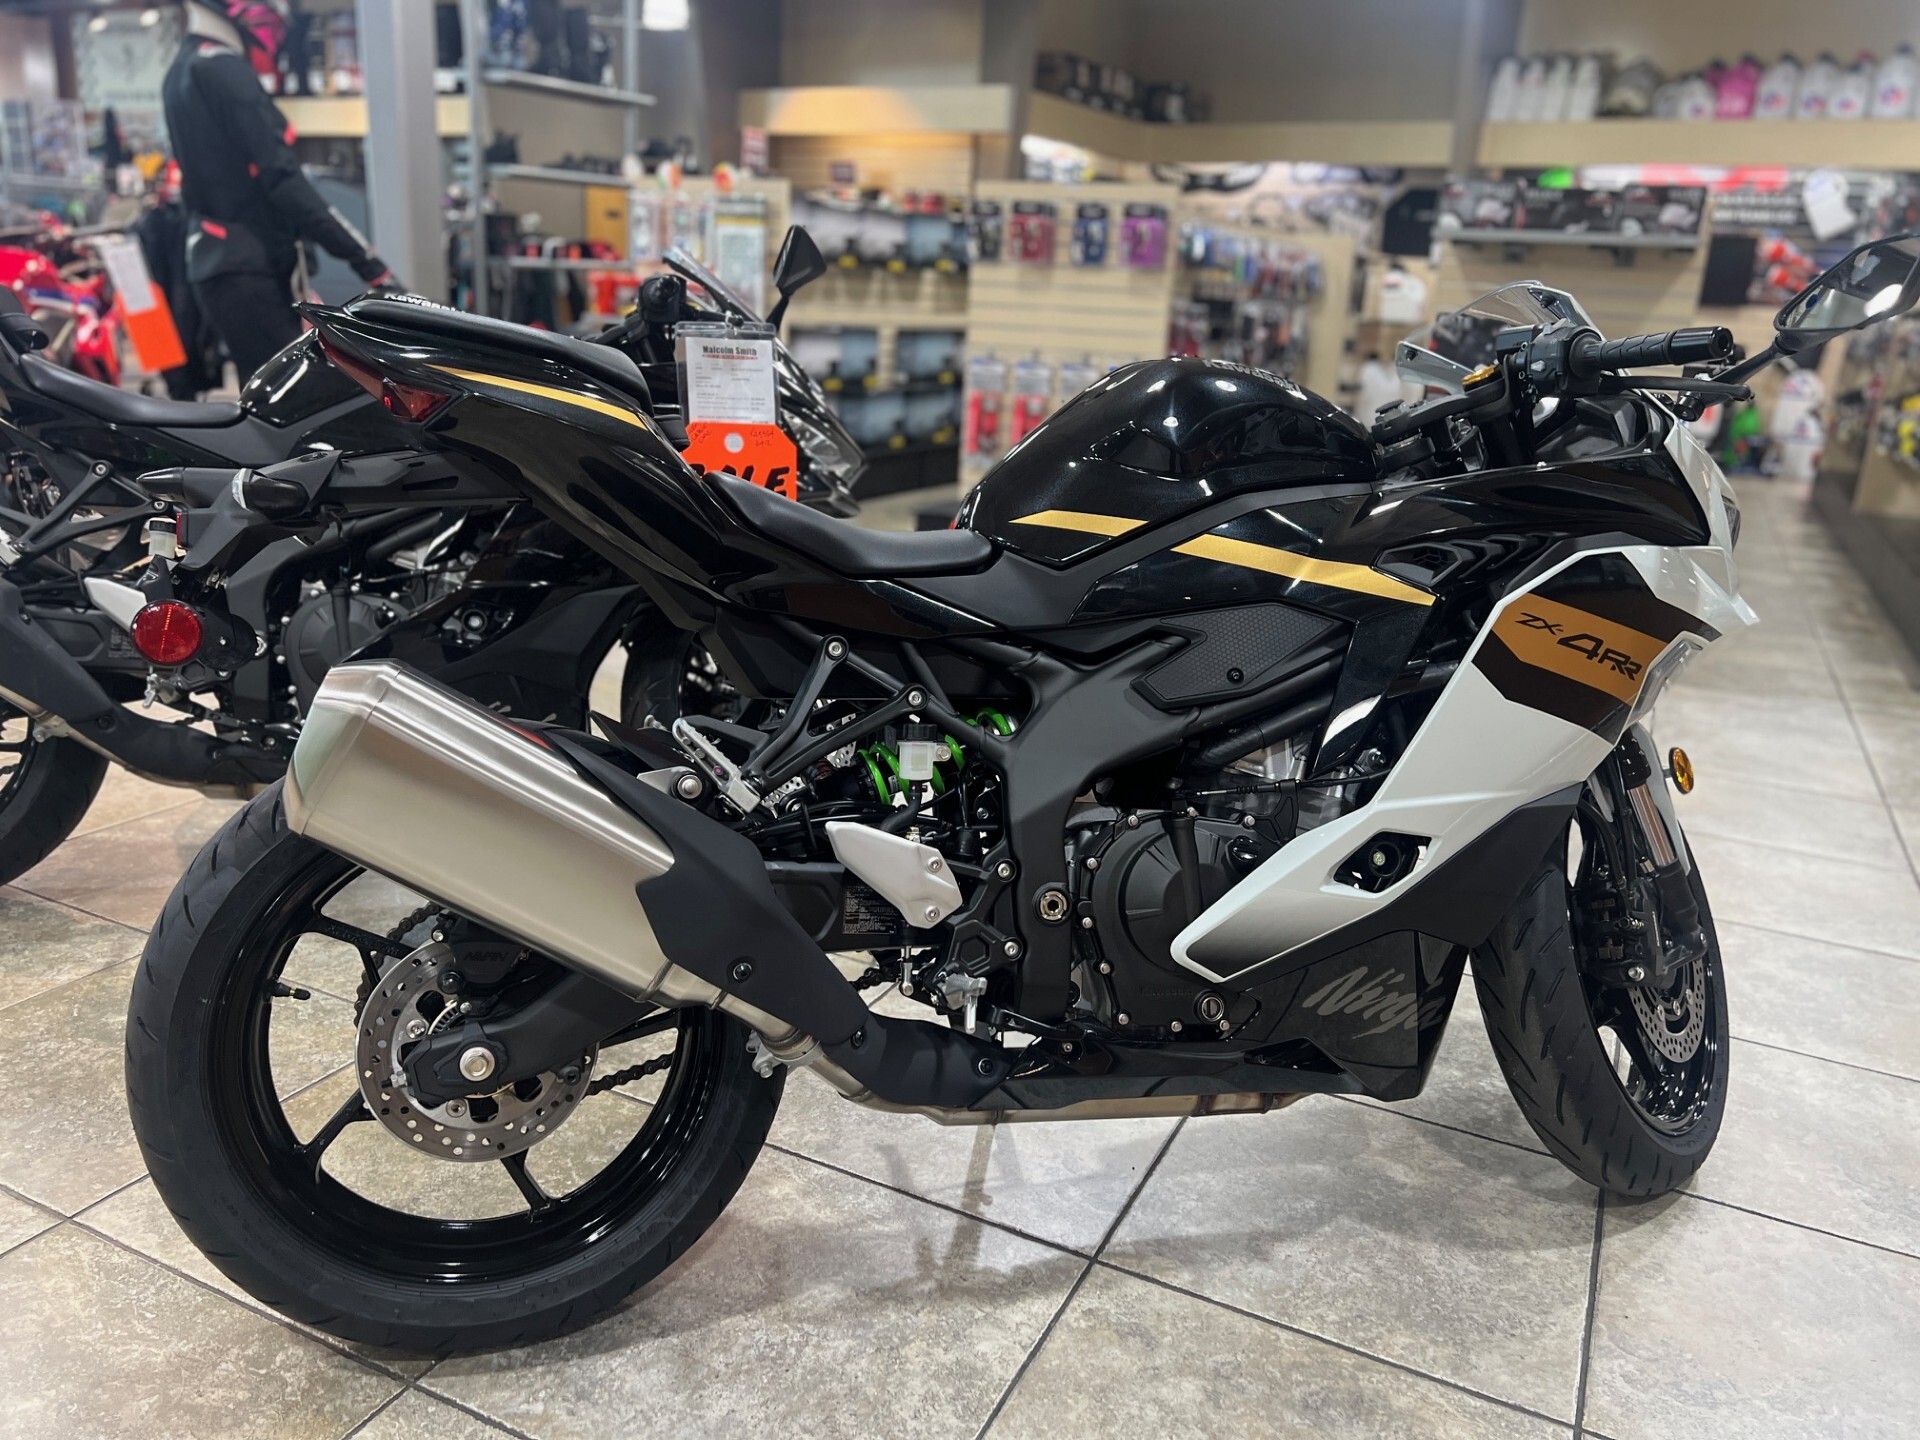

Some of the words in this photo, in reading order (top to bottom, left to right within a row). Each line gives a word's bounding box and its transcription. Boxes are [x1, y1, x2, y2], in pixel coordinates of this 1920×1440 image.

[702, 345, 734, 355] Malcolm
[735, 347, 758, 356] Smith
[1302, 966, 1446, 1040] Ninja
